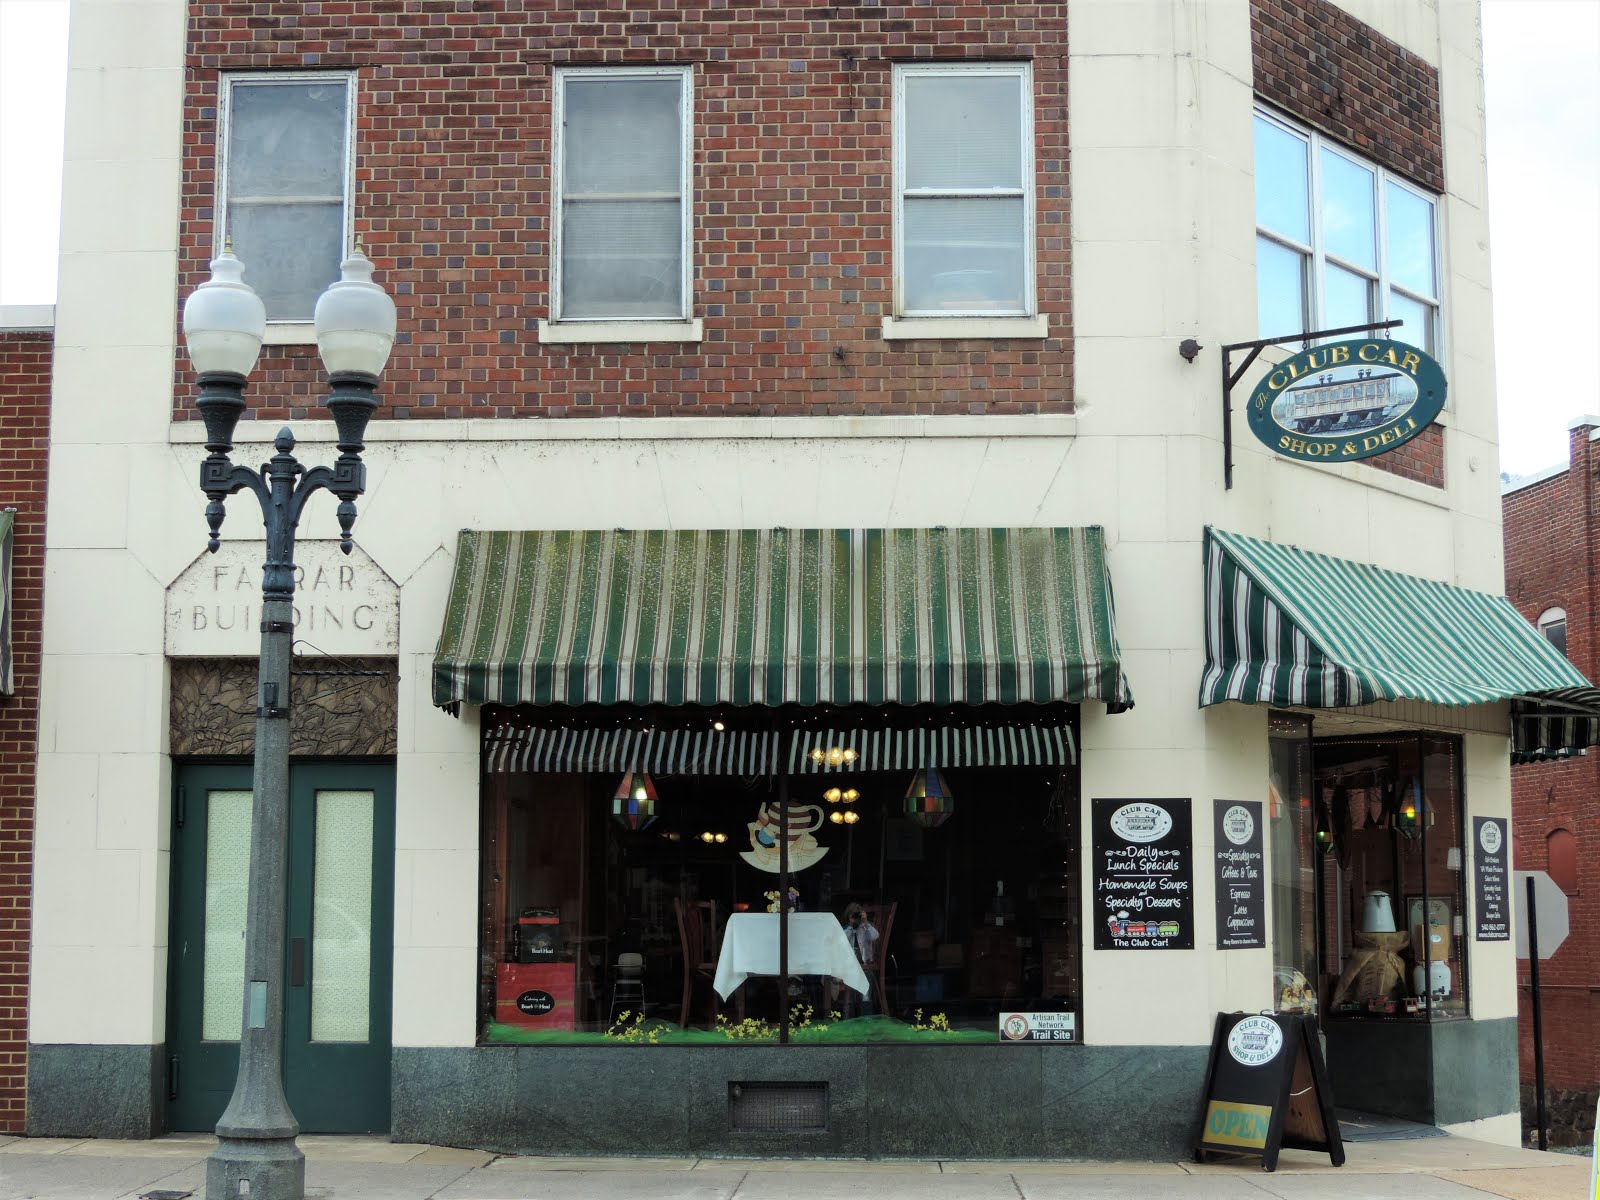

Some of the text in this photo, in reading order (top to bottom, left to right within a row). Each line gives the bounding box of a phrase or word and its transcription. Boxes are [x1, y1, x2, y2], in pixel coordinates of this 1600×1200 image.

[1268, 343, 1421, 390] CLUB CAR
[1278, 415, 1418, 457] SHOP & DELI
[213, 565, 355, 592] FARAR
[1120, 806, 1162, 817] CLUB CAR
[1126, 845, 1158, 861] Daily
[1107, 858, 1179, 874] Lunch Specials
[1098, 877, 1188, 893] Homemade Soups
[1138, 889, 1148, 897] and
[1105, 895, 1181, 911] Specialty Desserts
[1230, 888, 1251, 903] Espresso
[1233, 904, 1248, 915] Latte
[1227, 915, 1255, 931] Cappuccino
[1113, 938, 1169, 947] The Club Car!
[1032, 1013, 1070, 1021] Artisan Trail
[1038, 1021, 1064, 1029] Network
[1032, 1030, 1071, 1039] Trail Site
[1239, 1019, 1276, 1034] CLUB CAR
[1232, 1045, 1274, 1062] SHOP & DELI
[1208, 1108, 1271, 1141] OPEN
